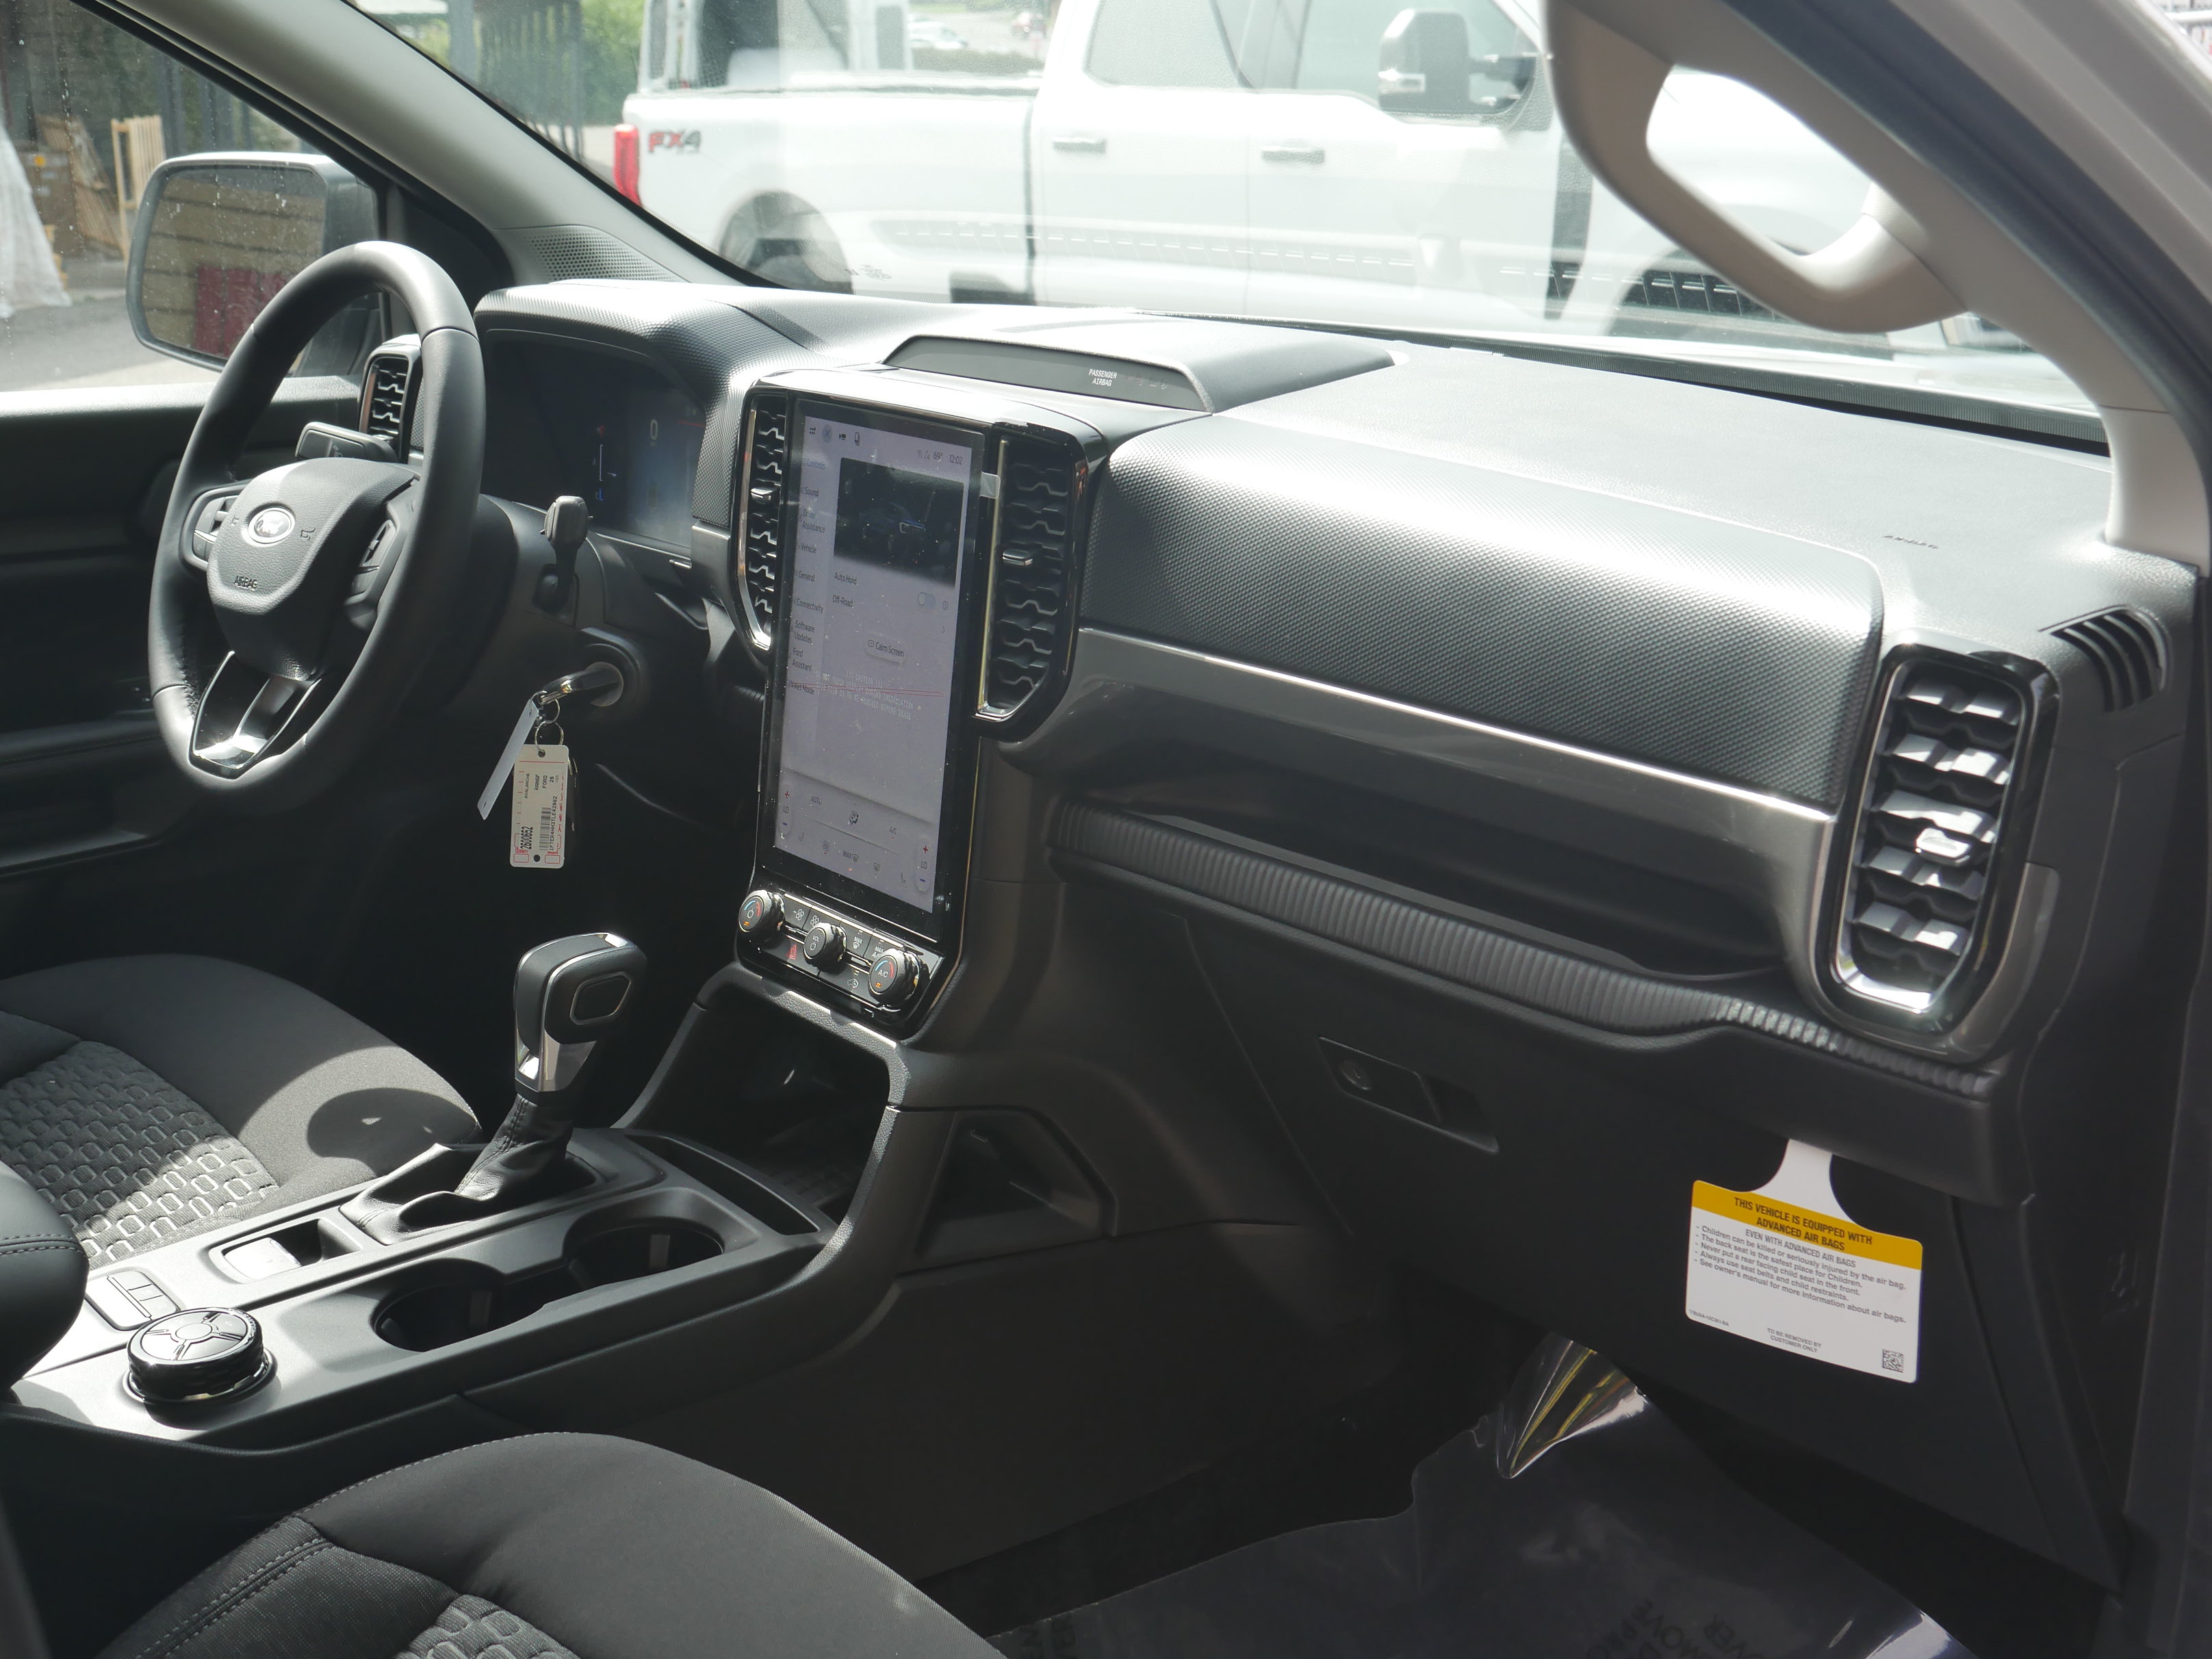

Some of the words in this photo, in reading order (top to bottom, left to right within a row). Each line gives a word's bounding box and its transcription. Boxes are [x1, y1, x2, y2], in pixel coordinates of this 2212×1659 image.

[647, 129, 702, 155] FX4
[1088, 369, 1117, 379] PASSENGER
[949, 454, 963, 465] 12:02
[805, 487, 819, 497] Sound
[802, 520, 825, 533] Assistance
[801, 543, 816, 554] Vehicle
[234, 576, 257, 589] AIRBAG
[798, 570, 815, 582] General
[835, 572, 846, 582] Auto
[846, 575, 857, 584] Hold
[797, 598, 824, 614] Connectivity
[832, 595, 853, 607] Off-Road
[795, 620, 815, 633] Software
[794, 632, 812, 644] Updates
[793, 647, 803, 658] Ford
[876, 642, 888, 652] Calm
[888, 646, 904, 657] Screen
[792, 660, 812, 672] Assistant
[802, 684, 815, 695] Mode
[810, 796, 821, 805] AUTO
[520, 826, 533, 849] 2600652
[843, 850, 852, 859] MAX
[877, 969, 888, 978] A/C
[1734, 1197, 1753, 1211] THIS
[1755, 1203, 1790, 1222] VEHICLE
[1792, 1215, 1800, 1225] IS
[1803, 1218, 1845, 1238] EQUIPPED
[1848, 1231, 1873, 1245] WITH
[1756, 1217, 1802, 1238] ADVANCED
[1804, 1232, 1819, 1244] AIR
[1822, 1236, 1845, 1251] BAGS
[1746, 1229, 1763, 1241] EVEN
[1764, 1235, 1782, 1246] WITH
[1784, 1242, 1821, 1258] ADVANCED
[1822, 1252, 1835, 1263] AIR
[1836, 1257, 1856, 1268] BAGS
[1701, 1233, 1714, 1244] The
[1716, 1237, 1732, 1249] back
[1734, 1245, 1749, 1255] seat
[1758, 1251, 1770, 1261] the
[1771, 1257, 1793, 1268] safest
[1794, 1263, 1814, 1275] place
[1827, 1273, 1863, 1288] Children.
[1702, 1225, 1731, 1240] Children
[1732, 1235, 1745, 1244] can
[1747, 1237, 1756, 1247] be
[1757, 1241, 1775, 1255] killed
[1787, 1252, 1821, 1269] seriously
[1822, 1262, 1848, 1276] injured
[1850, 1270, 1860, 1280] by
[1862, 1273, 1874, 1283] the
[1876, 1277, 1887, 1285] air
[1889, 1280, 1906, 1291] bag.
[1700, 1250, 1725, 1263] Always
[1726, 1260, 1739, 1268] use
[1741, 1265, 1756, 1274] seat
[1757, 1269, 1775, 1280] belts
[1775, 1274, 1790, 1284] and
[1791, 1280, 1810, 1291] child
[1811, 1285, 1849, 1301] restraints.
[1701, 1242, 1721, 1253] Never
[1722, 1250, 1734, 1259] put
[1741, 1255, 1755, 1265] rear
[1757, 1259, 1778, 1273] facing
[1779, 1266, 1799, 1278] child
[1799, 1274, 1815, 1283] seat
[1825, 1281, 1838, 1290] the
[1840, 1285, 1861, 1296] front.
[1700, 1259, 1713, 1268] See
[1714, 1265, 1741, 1277] owner's
[1742, 1273, 1769, 1286] manual
[1770, 1281, 1780, 1289] for
[1782, 1285, 1801, 1296] more
[1802, 1292, 1845, 1309] information
[1847, 1304, 1870, 1315] about
[1872, 1309, 1882, 1317] air
[1883, 1312, 1907, 1324] bags.
[1771, 1335, 1802, 1349] CUSTOMER
[1803, 1344, 1818, 1353] ONLY
[1785, 1333, 1813, 1346] REMOVED
